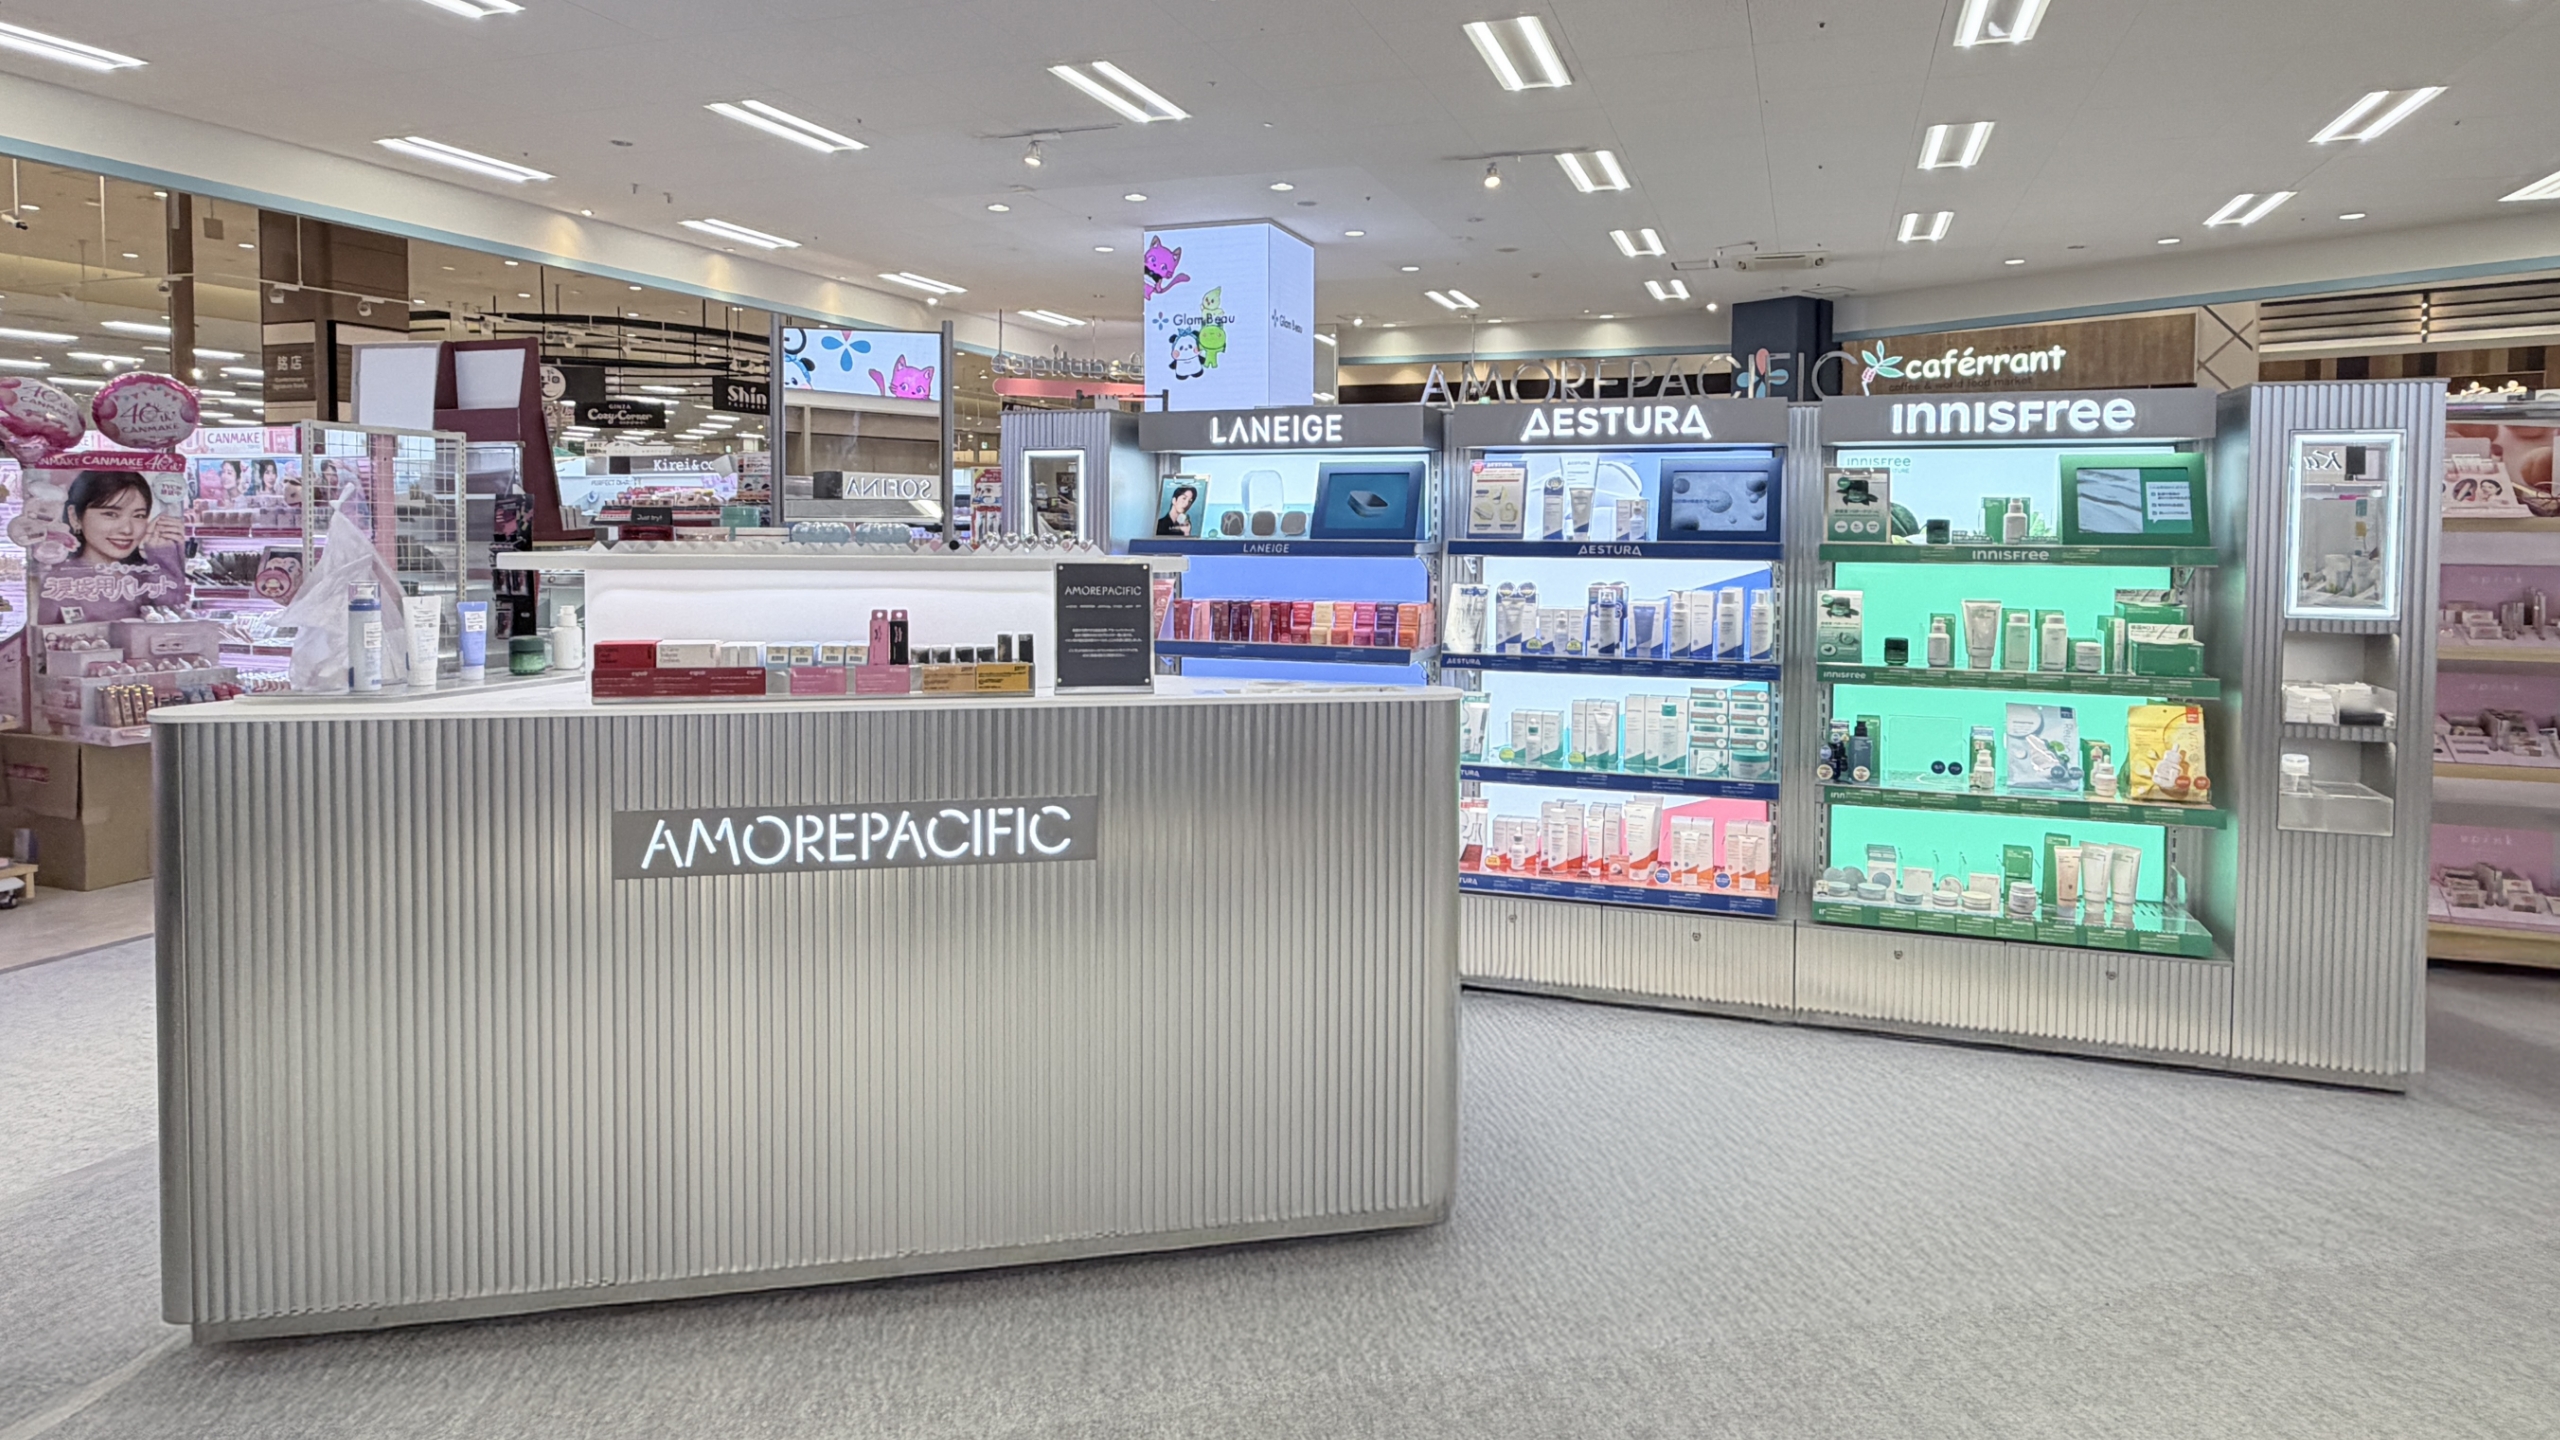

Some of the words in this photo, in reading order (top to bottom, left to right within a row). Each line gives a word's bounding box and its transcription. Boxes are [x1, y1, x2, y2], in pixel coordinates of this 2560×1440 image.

[1173, 313, 1202, 326] Glam
[1206, 313, 1235, 325] Beau
[1905, 345, 2067, 380] caférrant
[1420, 351, 1859, 408] AMOREPACIFIC
[1889, 382, 1920, 391] coffee
[1967, 377, 1991, 387] food
[727, 385, 767, 405] Shin
[121, 424, 179, 434] CANMAKE
[1212, 414, 1343, 444] LANEIGE
[1520, 404, 1712, 442] AESTURA
[207, 432, 260, 444] CANMAKE
[82, 455, 144, 467] CANMAKE
[1243, 543, 1290, 554] LANEIGE
[1577, 545, 1642, 556] AESTURA
[41, 576, 178, 602] 涙袋用パレット
[1064, 585, 1142, 596] AMOREPACIFIC
[1446, 657, 1481, 666] AESTURA
[641, 804, 1072, 870] AMOREPACIFIC
